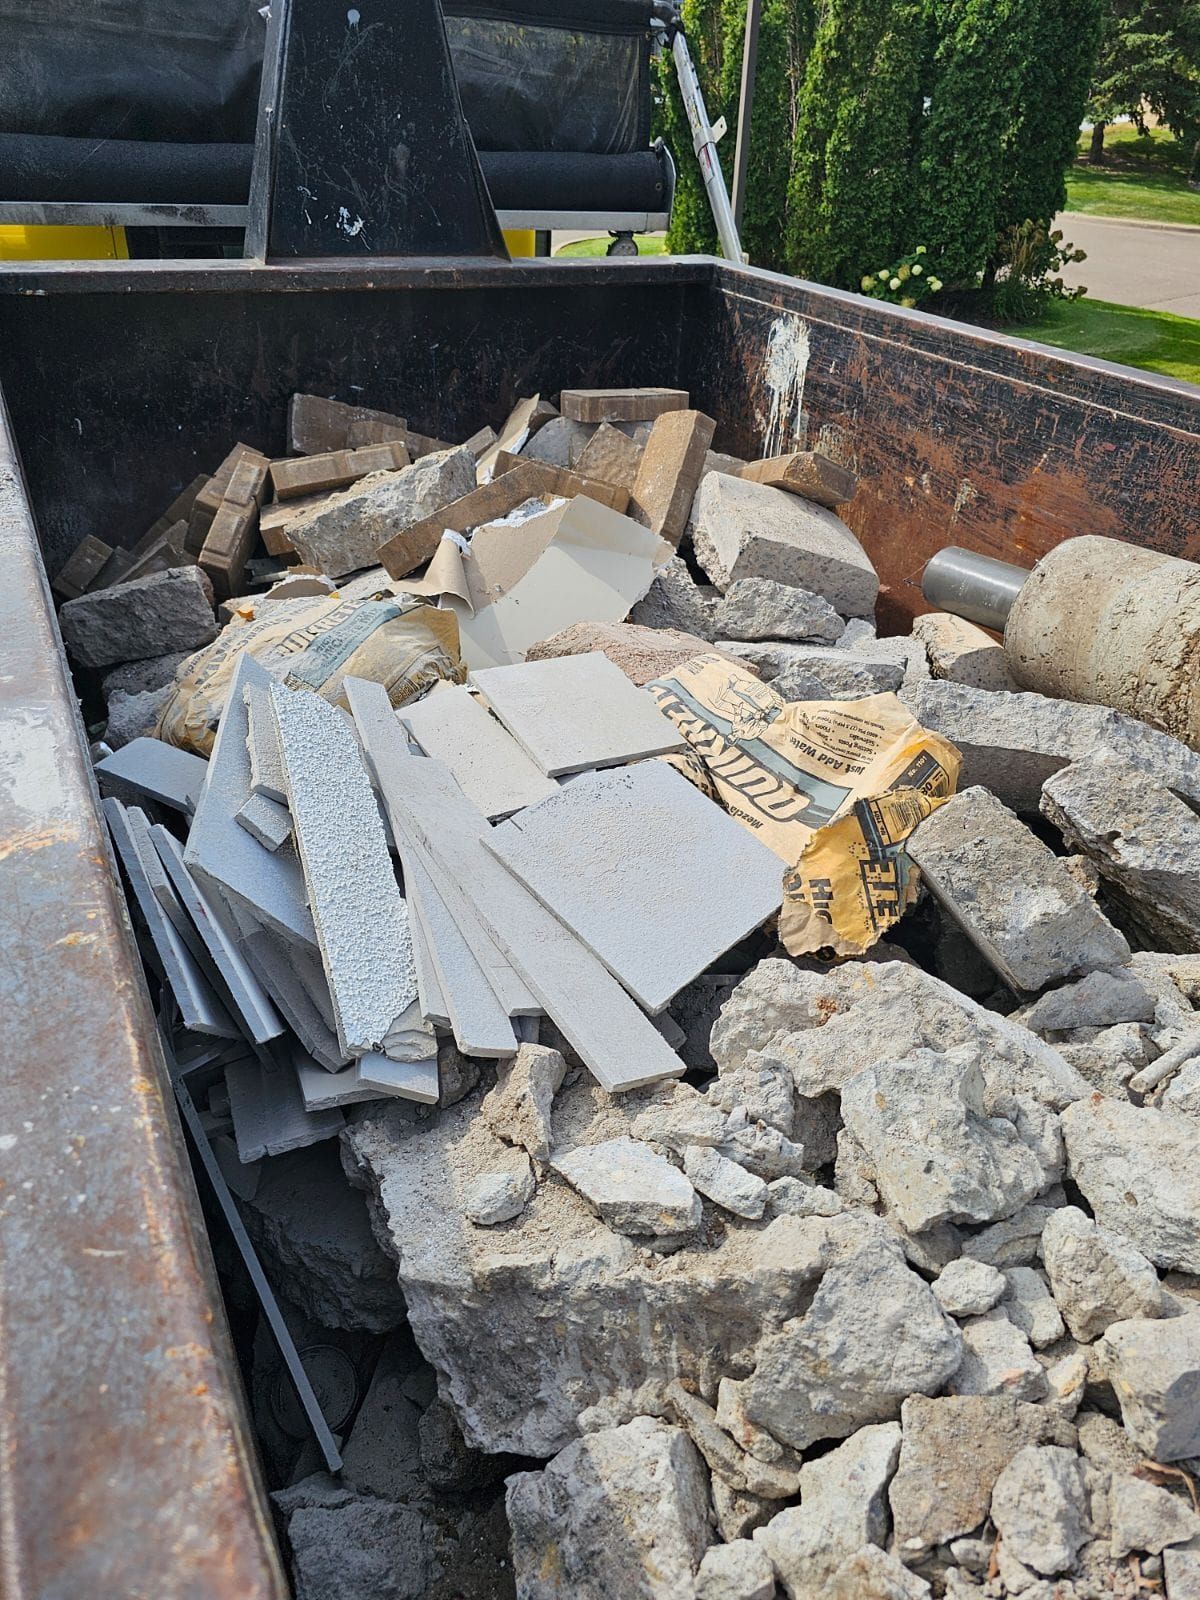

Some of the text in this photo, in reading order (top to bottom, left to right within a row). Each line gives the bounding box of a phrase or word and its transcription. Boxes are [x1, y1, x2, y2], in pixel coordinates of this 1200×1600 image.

[838, 739, 852, 748] Posts
[848, 733, 874, 746] Sidewalks
[648, 684, 812, 822] QUIKRET
[853, 742, 872, 754] Setting
[816, 753, 842, 769] Add
[906, 755, 926, 778] No. 1101
[845, 764, 865, 775] Just
[729, 805, 763, 829] Mezcla
